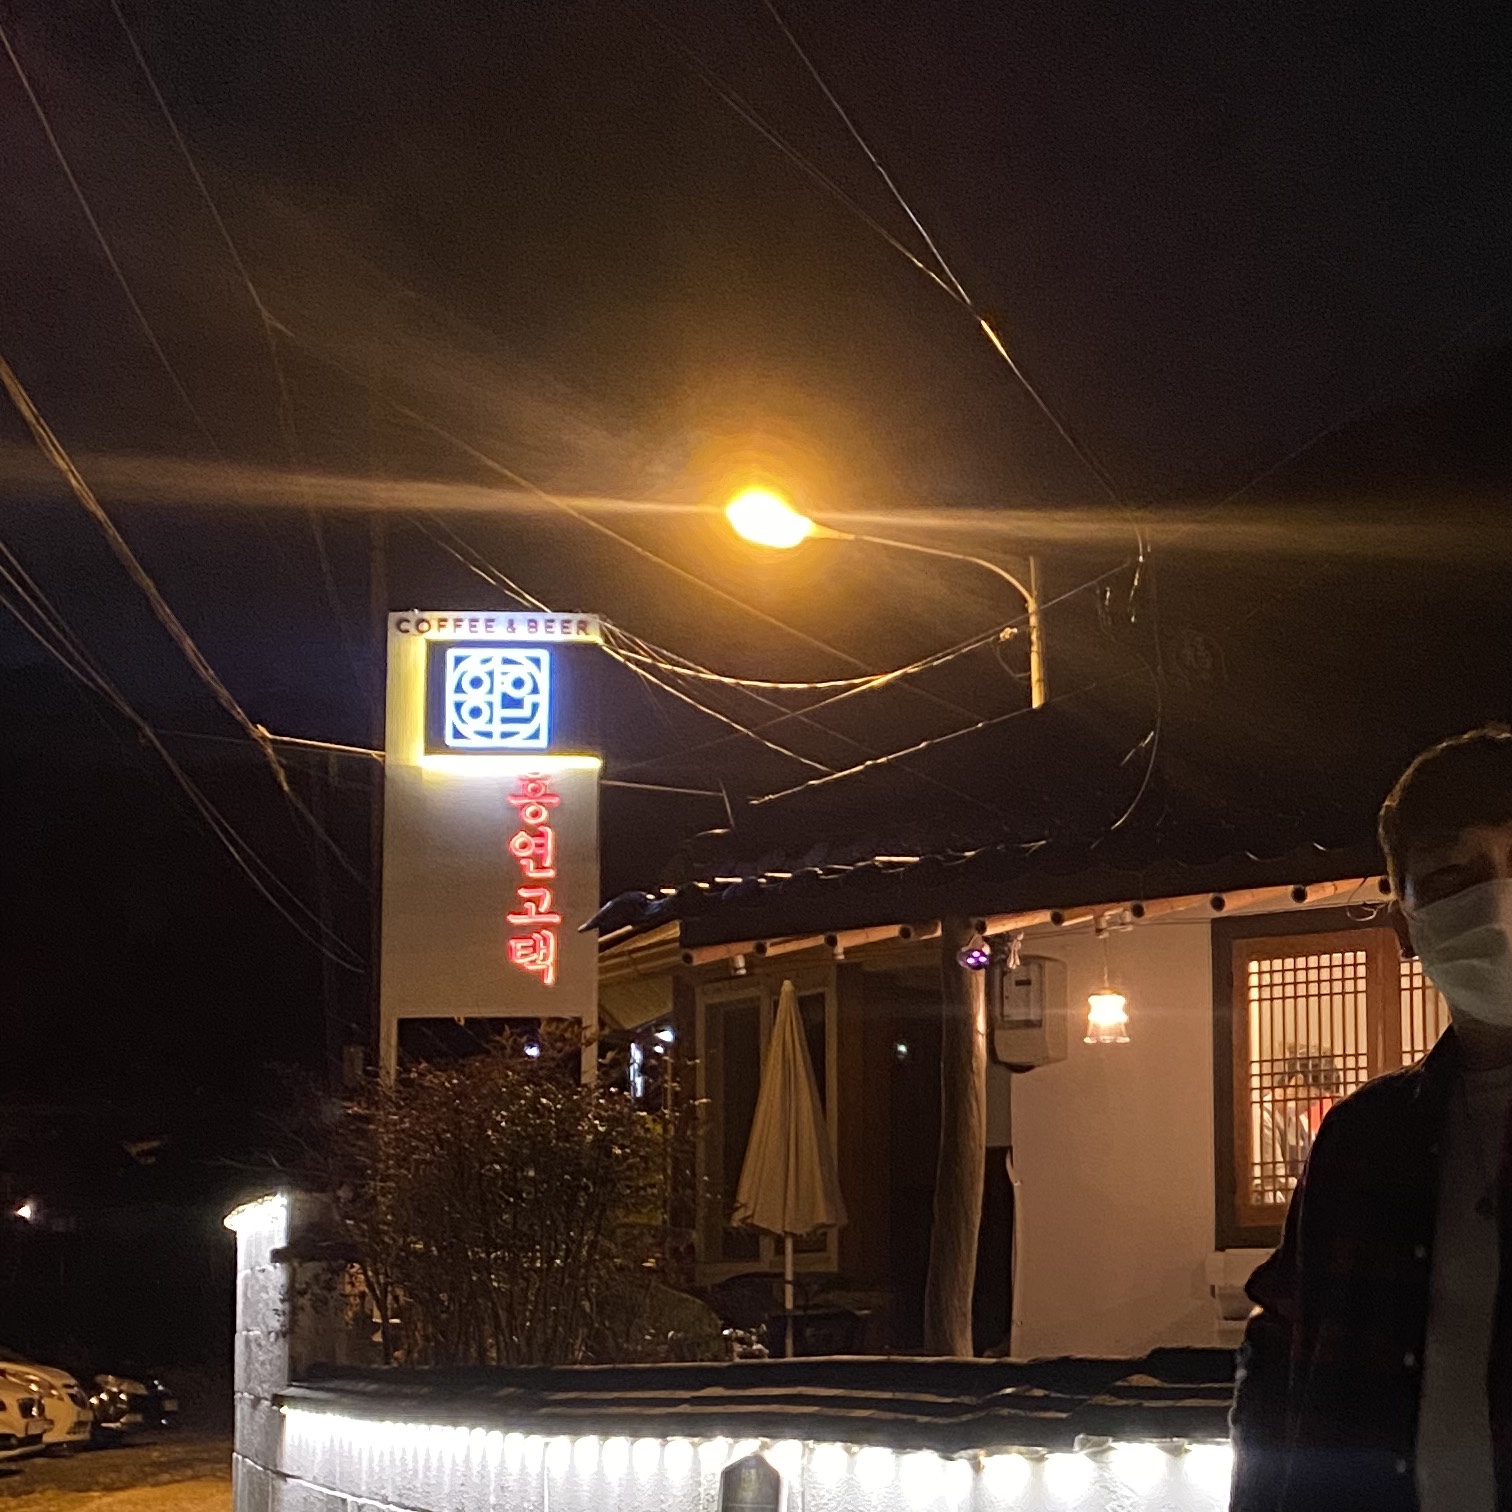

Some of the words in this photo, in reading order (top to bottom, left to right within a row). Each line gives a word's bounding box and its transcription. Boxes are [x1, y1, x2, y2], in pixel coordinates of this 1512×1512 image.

[395, 617, 496, 635] COFFEE
[506, 617, 518, 634] &
[526, 618, 591, 636] BEER
[506, 771, 561, 986] 홍연고택
